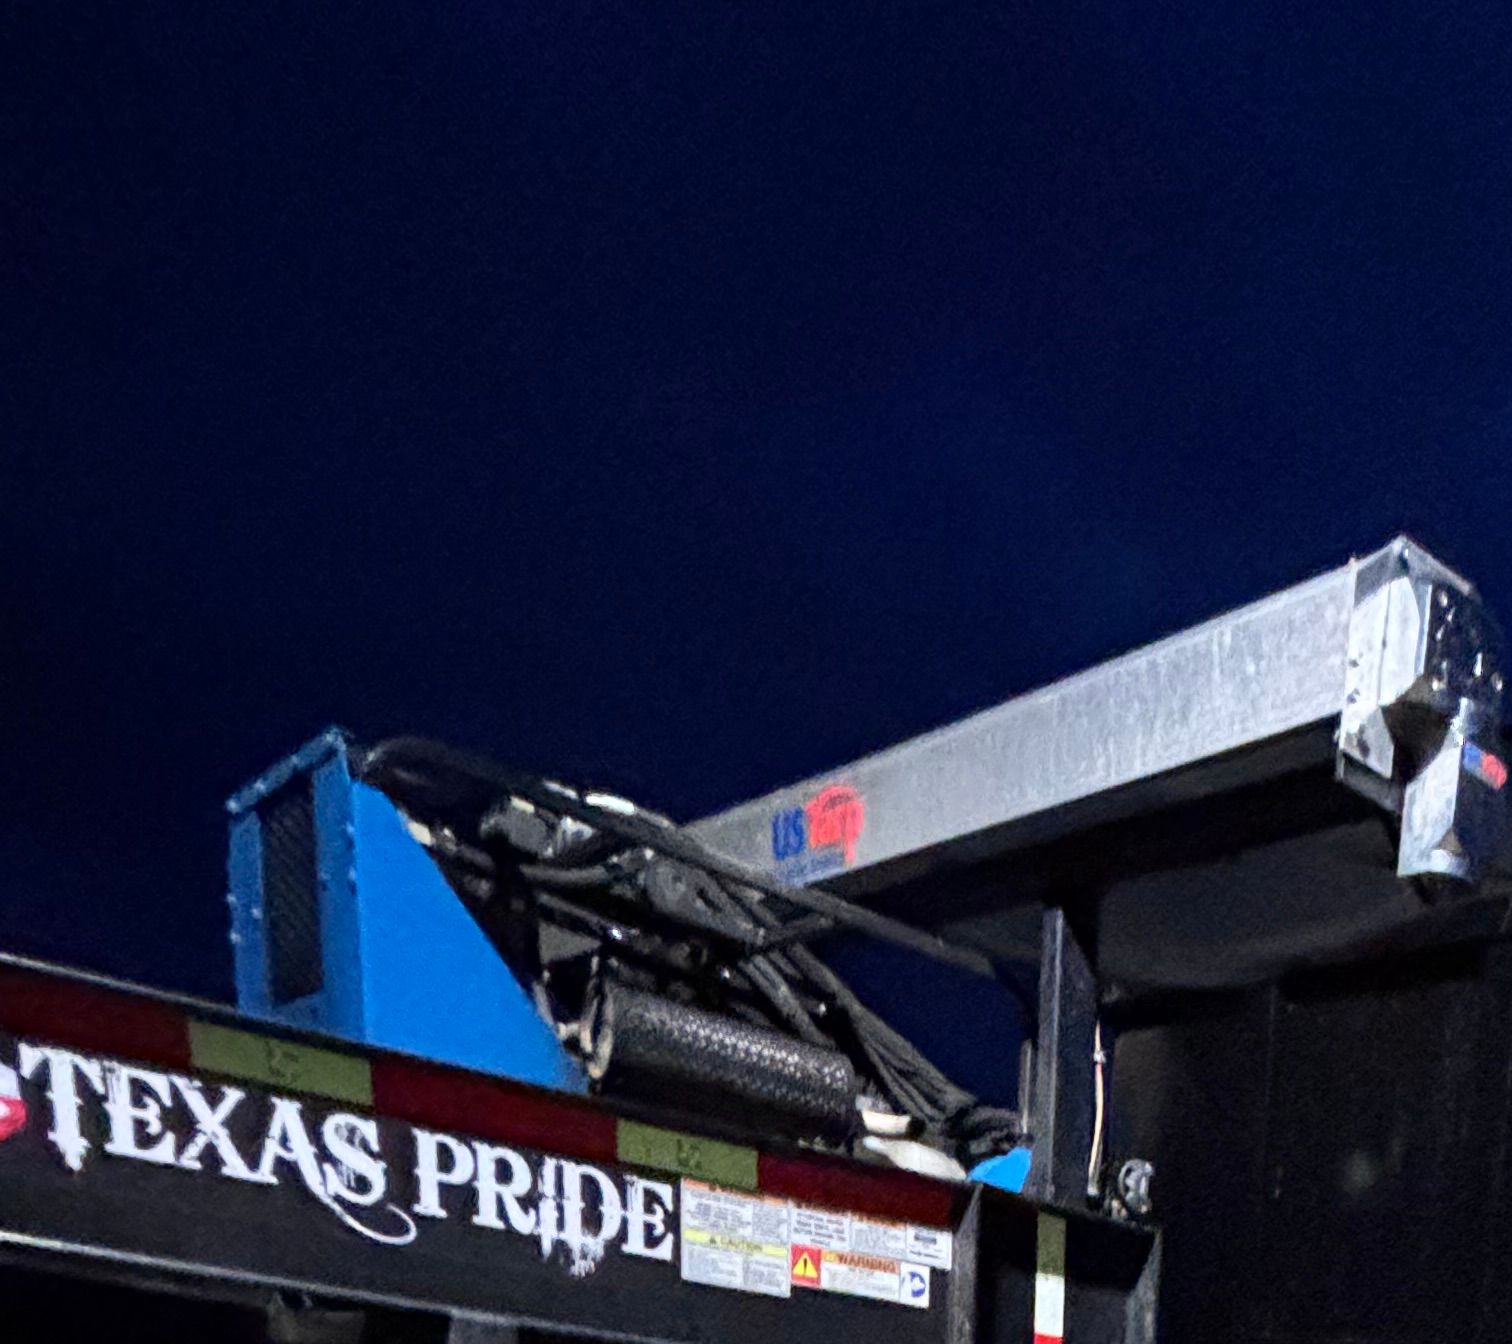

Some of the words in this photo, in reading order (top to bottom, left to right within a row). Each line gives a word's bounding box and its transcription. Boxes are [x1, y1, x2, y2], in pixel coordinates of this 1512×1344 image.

[771, 806, 805, 861] US
[18, 1042, 417, 1245] TEXAS
[411, 1127, 673, 1278] PRIDE
[838, 1253, 896, 1274] WARNING
